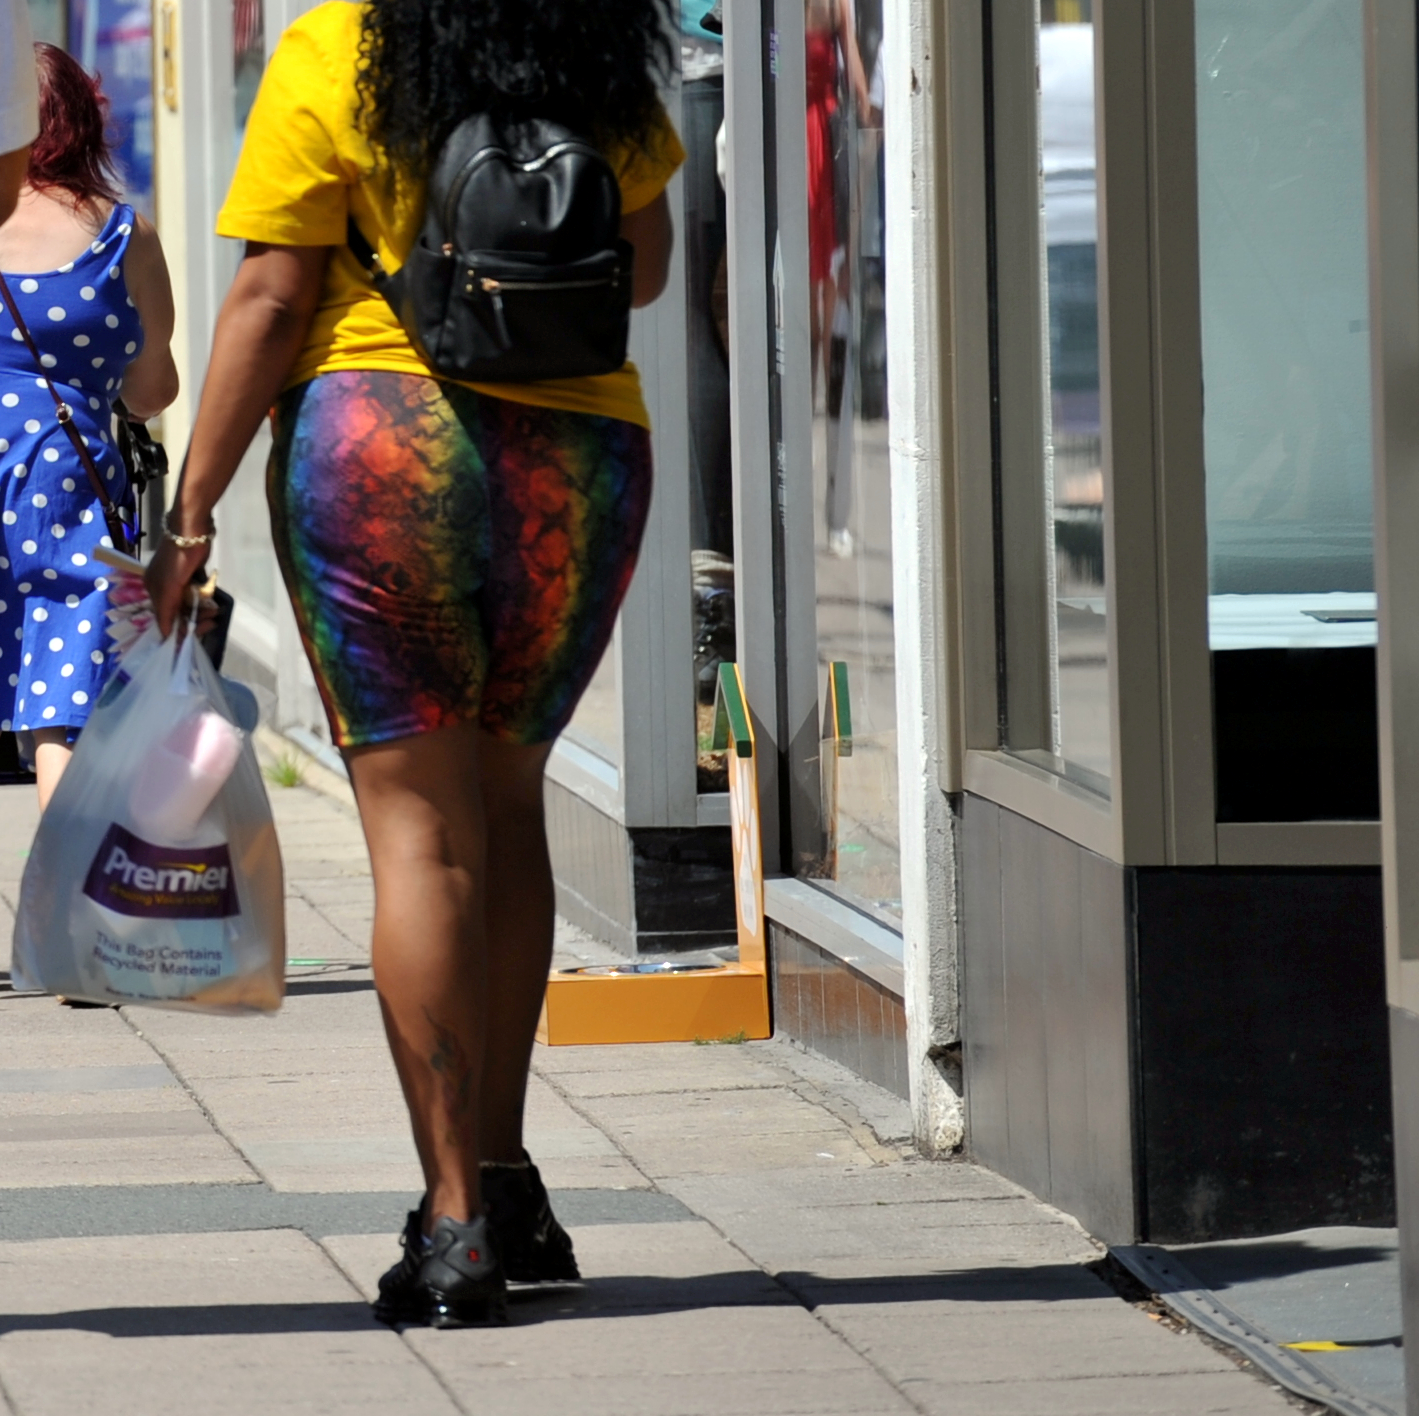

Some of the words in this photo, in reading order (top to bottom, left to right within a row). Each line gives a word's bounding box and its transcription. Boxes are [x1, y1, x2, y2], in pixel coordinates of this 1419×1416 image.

[103, 846, 229, 892] Premier
[93, 945, 156, 970] Recycled
[160, 962, 221, 977] Material
[96, 930, 122, 953] This
[126, 942, 155, 961] Bag
[159, 946, 223, 961] Contains
